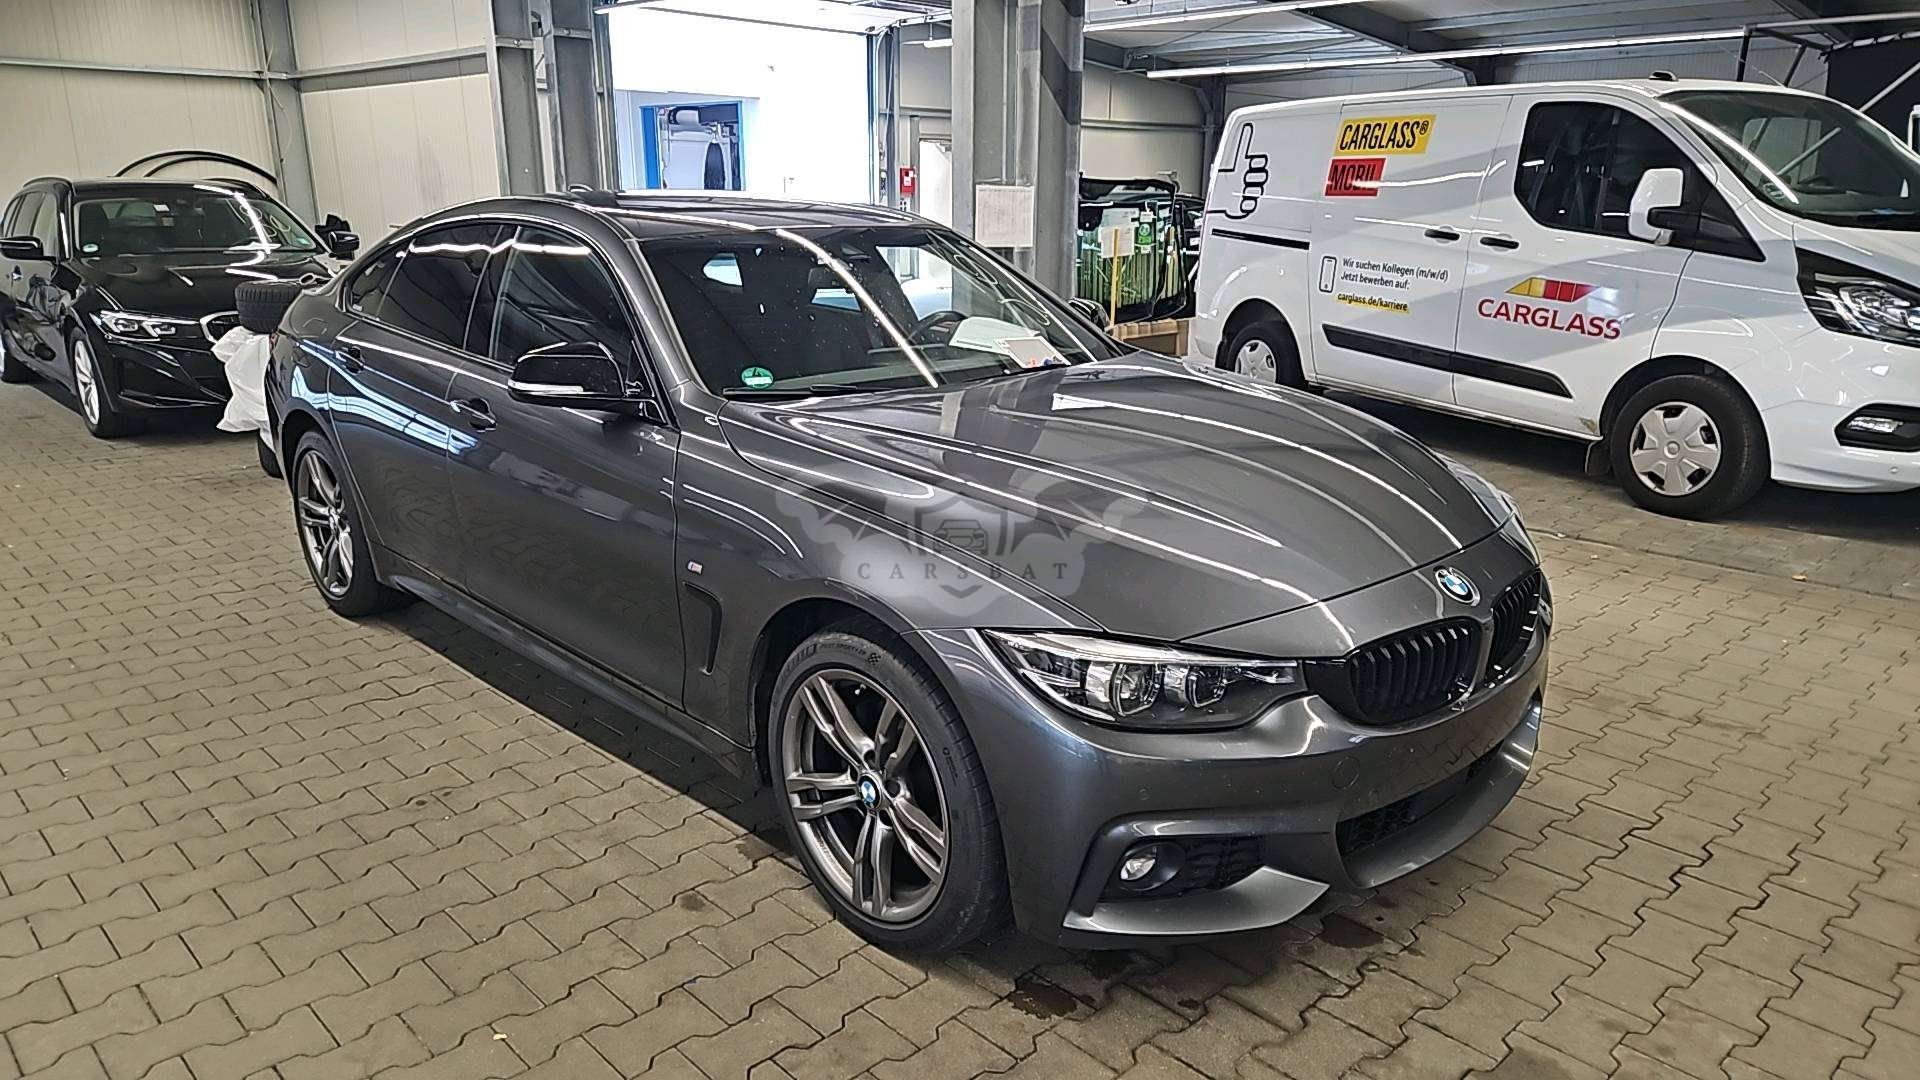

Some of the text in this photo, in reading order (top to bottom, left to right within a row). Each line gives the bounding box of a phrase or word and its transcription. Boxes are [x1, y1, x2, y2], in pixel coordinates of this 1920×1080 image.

[1340, 120, 1429, 150] CARGLASS®
[1328, 164, 1376, 190] MOBIL
[1341, 272, 1410, 290] Jetzt bewerben auf:
[1343, 258, 1448, 282] Wir suchen Kollegen (m/w/d)
[1337, 292, 1408, 311] carglass.de/karriere
[1478, 299, 1621, 340] CARGLASS
